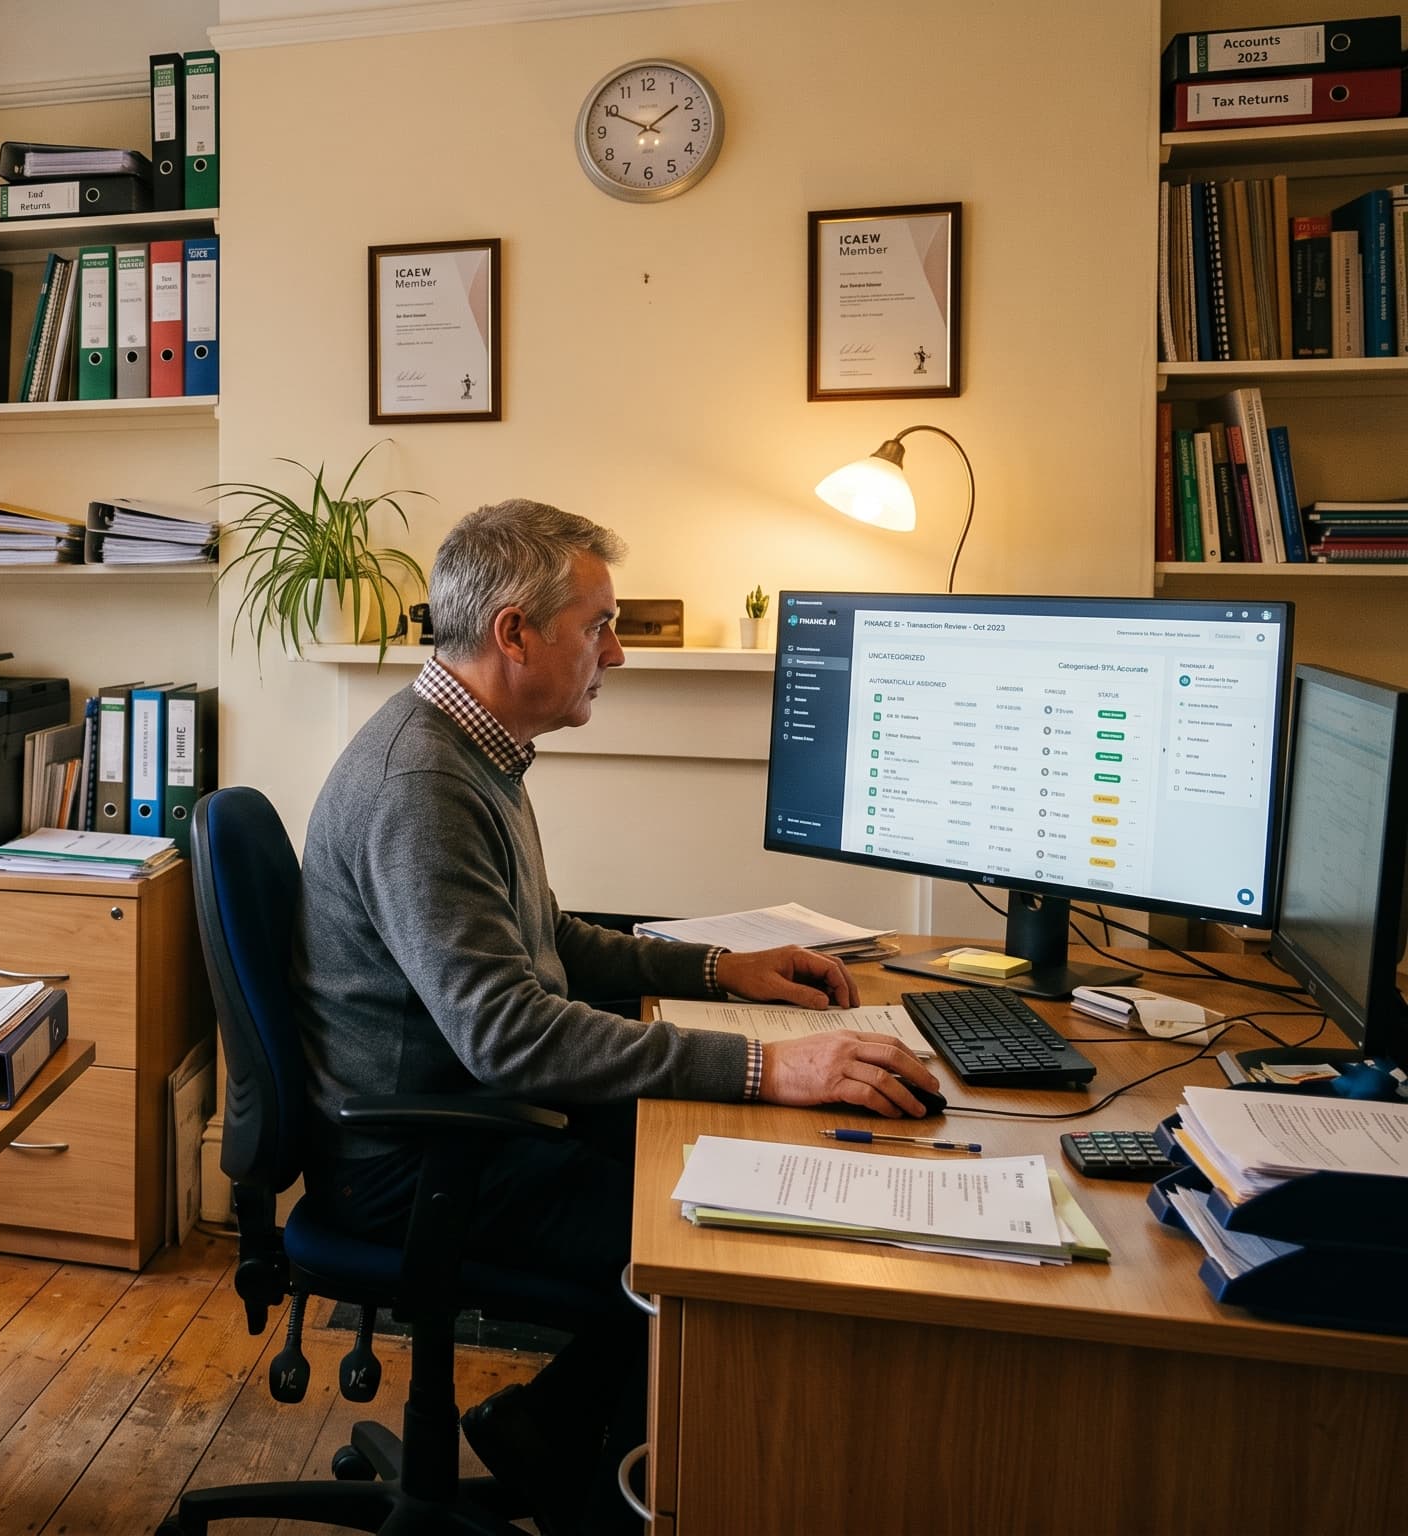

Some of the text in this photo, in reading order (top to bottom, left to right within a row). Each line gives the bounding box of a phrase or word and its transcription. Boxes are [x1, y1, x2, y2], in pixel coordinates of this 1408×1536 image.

[1223, 36, 1281, 49] Accounts
[1237, 51, 1269, 63] 2023
[640, 77, 656, 91] 12
[669, 82, 674, 95] 1
[620, 86, 631, 99] 11
[684, 96, 694, 110] 2
[1212, 94, 1289, 107] Tax Returns
[691, 118, 701, 132] 3
[597, 126, 607, 139] 9
[605, 148, 615, 161] 8
[684, 142, 695, 155] 4
[622, 162, 632, 175] 7
[667, 159, 677, 173] 5
[643, 166, 654, 180] 6
[20, 202, 51, 211] Returns
[839, 233, 881, 245] ICAEW
[839, 245, 888, 256] Member
[395, 267, 431, 278] ICAEW
[395, 279, 437, 289] Member
[987, 624, 1006, 632] 2023
[868, 652, 926, 661] UNCATEGORIZED
